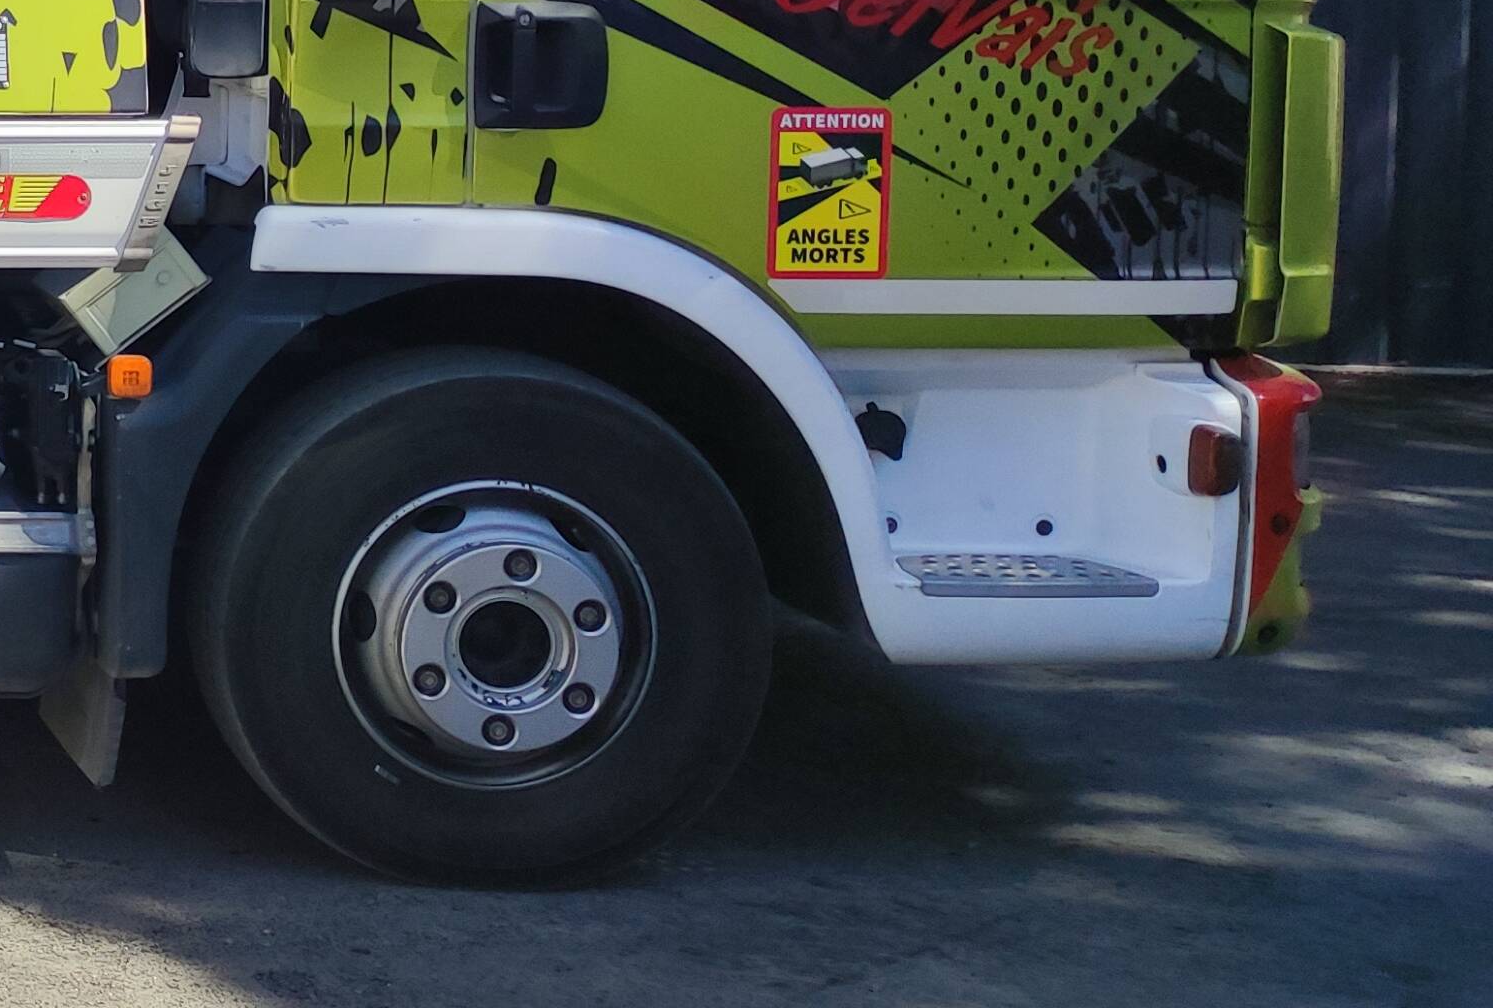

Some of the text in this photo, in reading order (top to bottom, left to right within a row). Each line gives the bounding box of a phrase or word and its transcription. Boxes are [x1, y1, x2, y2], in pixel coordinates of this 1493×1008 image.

[779, 113, 885, 129] ATTENTION
[787, 228, 870, 245] ANGLES
[791, 247, 866, 264] MORTS
